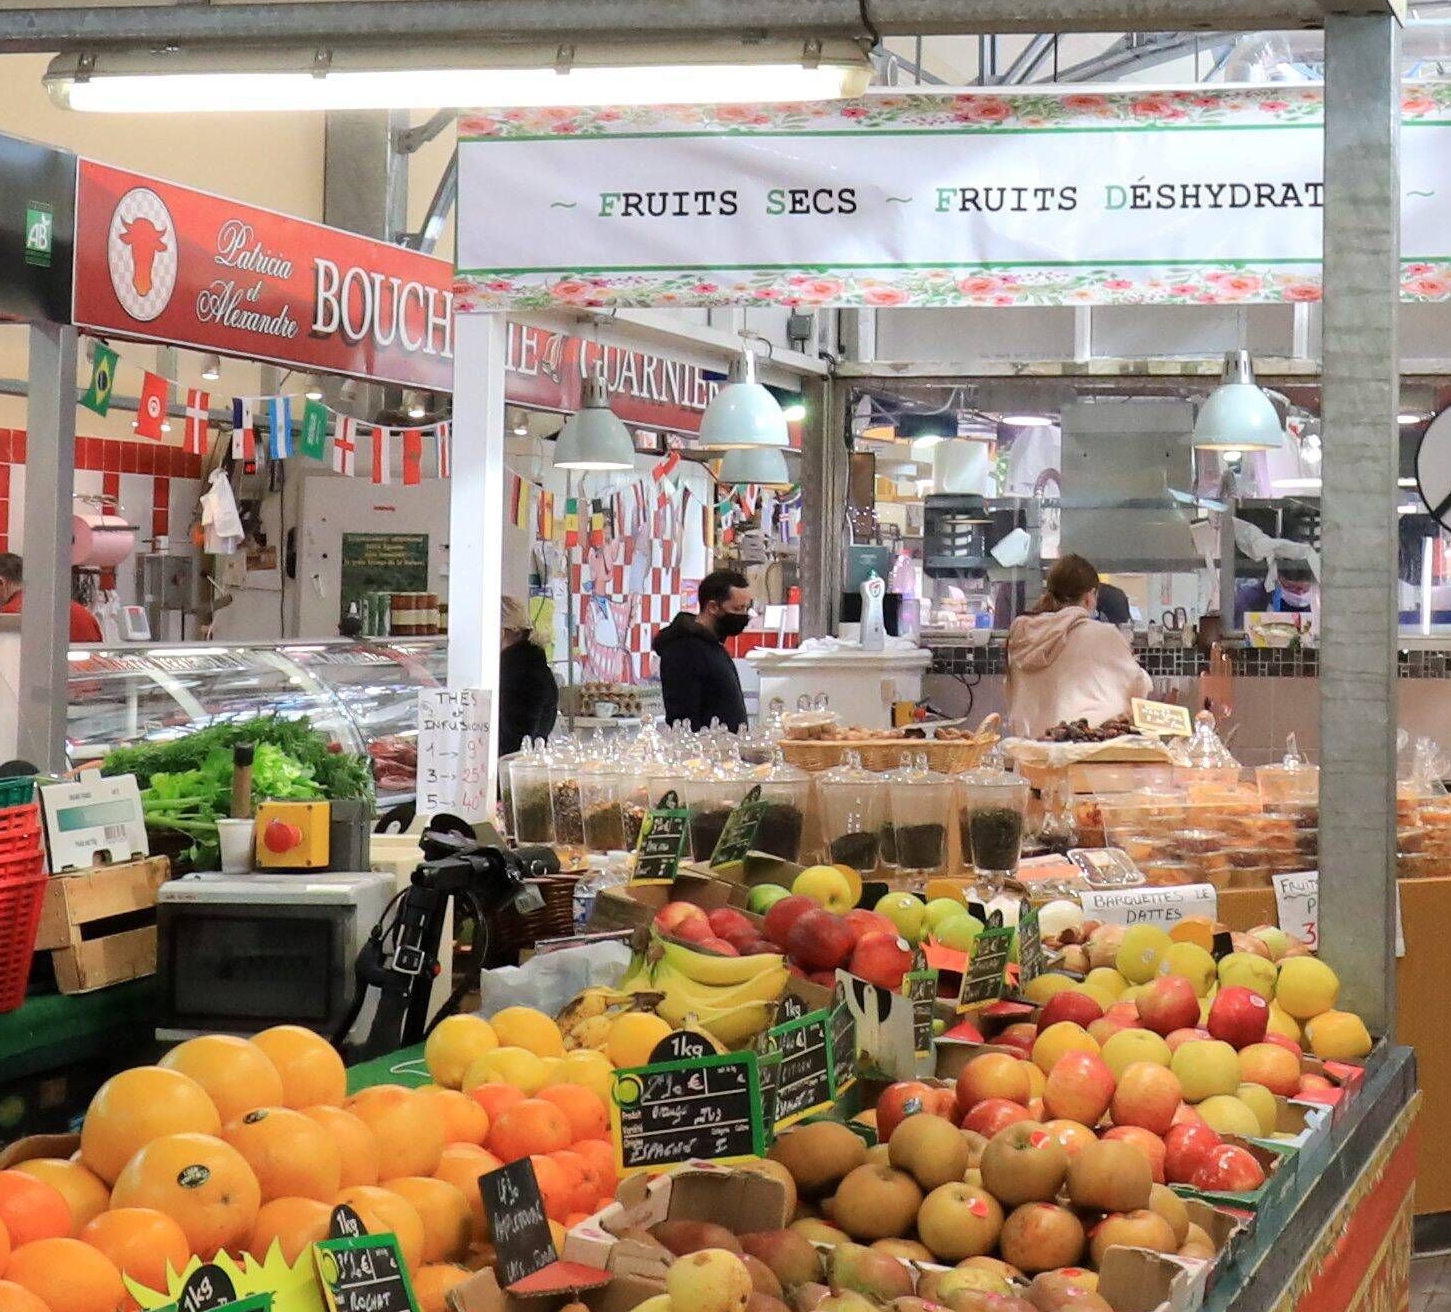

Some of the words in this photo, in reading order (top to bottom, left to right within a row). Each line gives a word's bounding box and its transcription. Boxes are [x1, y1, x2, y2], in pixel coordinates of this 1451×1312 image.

[599, 190, 738, 218] FRUITS
[767, 188, 858, 217] SECS
[936, 185, 1078, 214] FRUITS
[26, 223, 50, 251] AB
[215, 220, 292, 279] Patricia
[247, 280, 260, 302] et
[197, 280, 298, 337] Alexandre
[427, 769, 439, 783] 3
[427, 794, 438, 809] 5
[1093, 891, 1184, 908] BARQUETTES
[1126, 907, 1182, 924] DATTES
[671, 1036, 703, 1059] 1kg
[337, 1210, 359, 1238] 1kg
